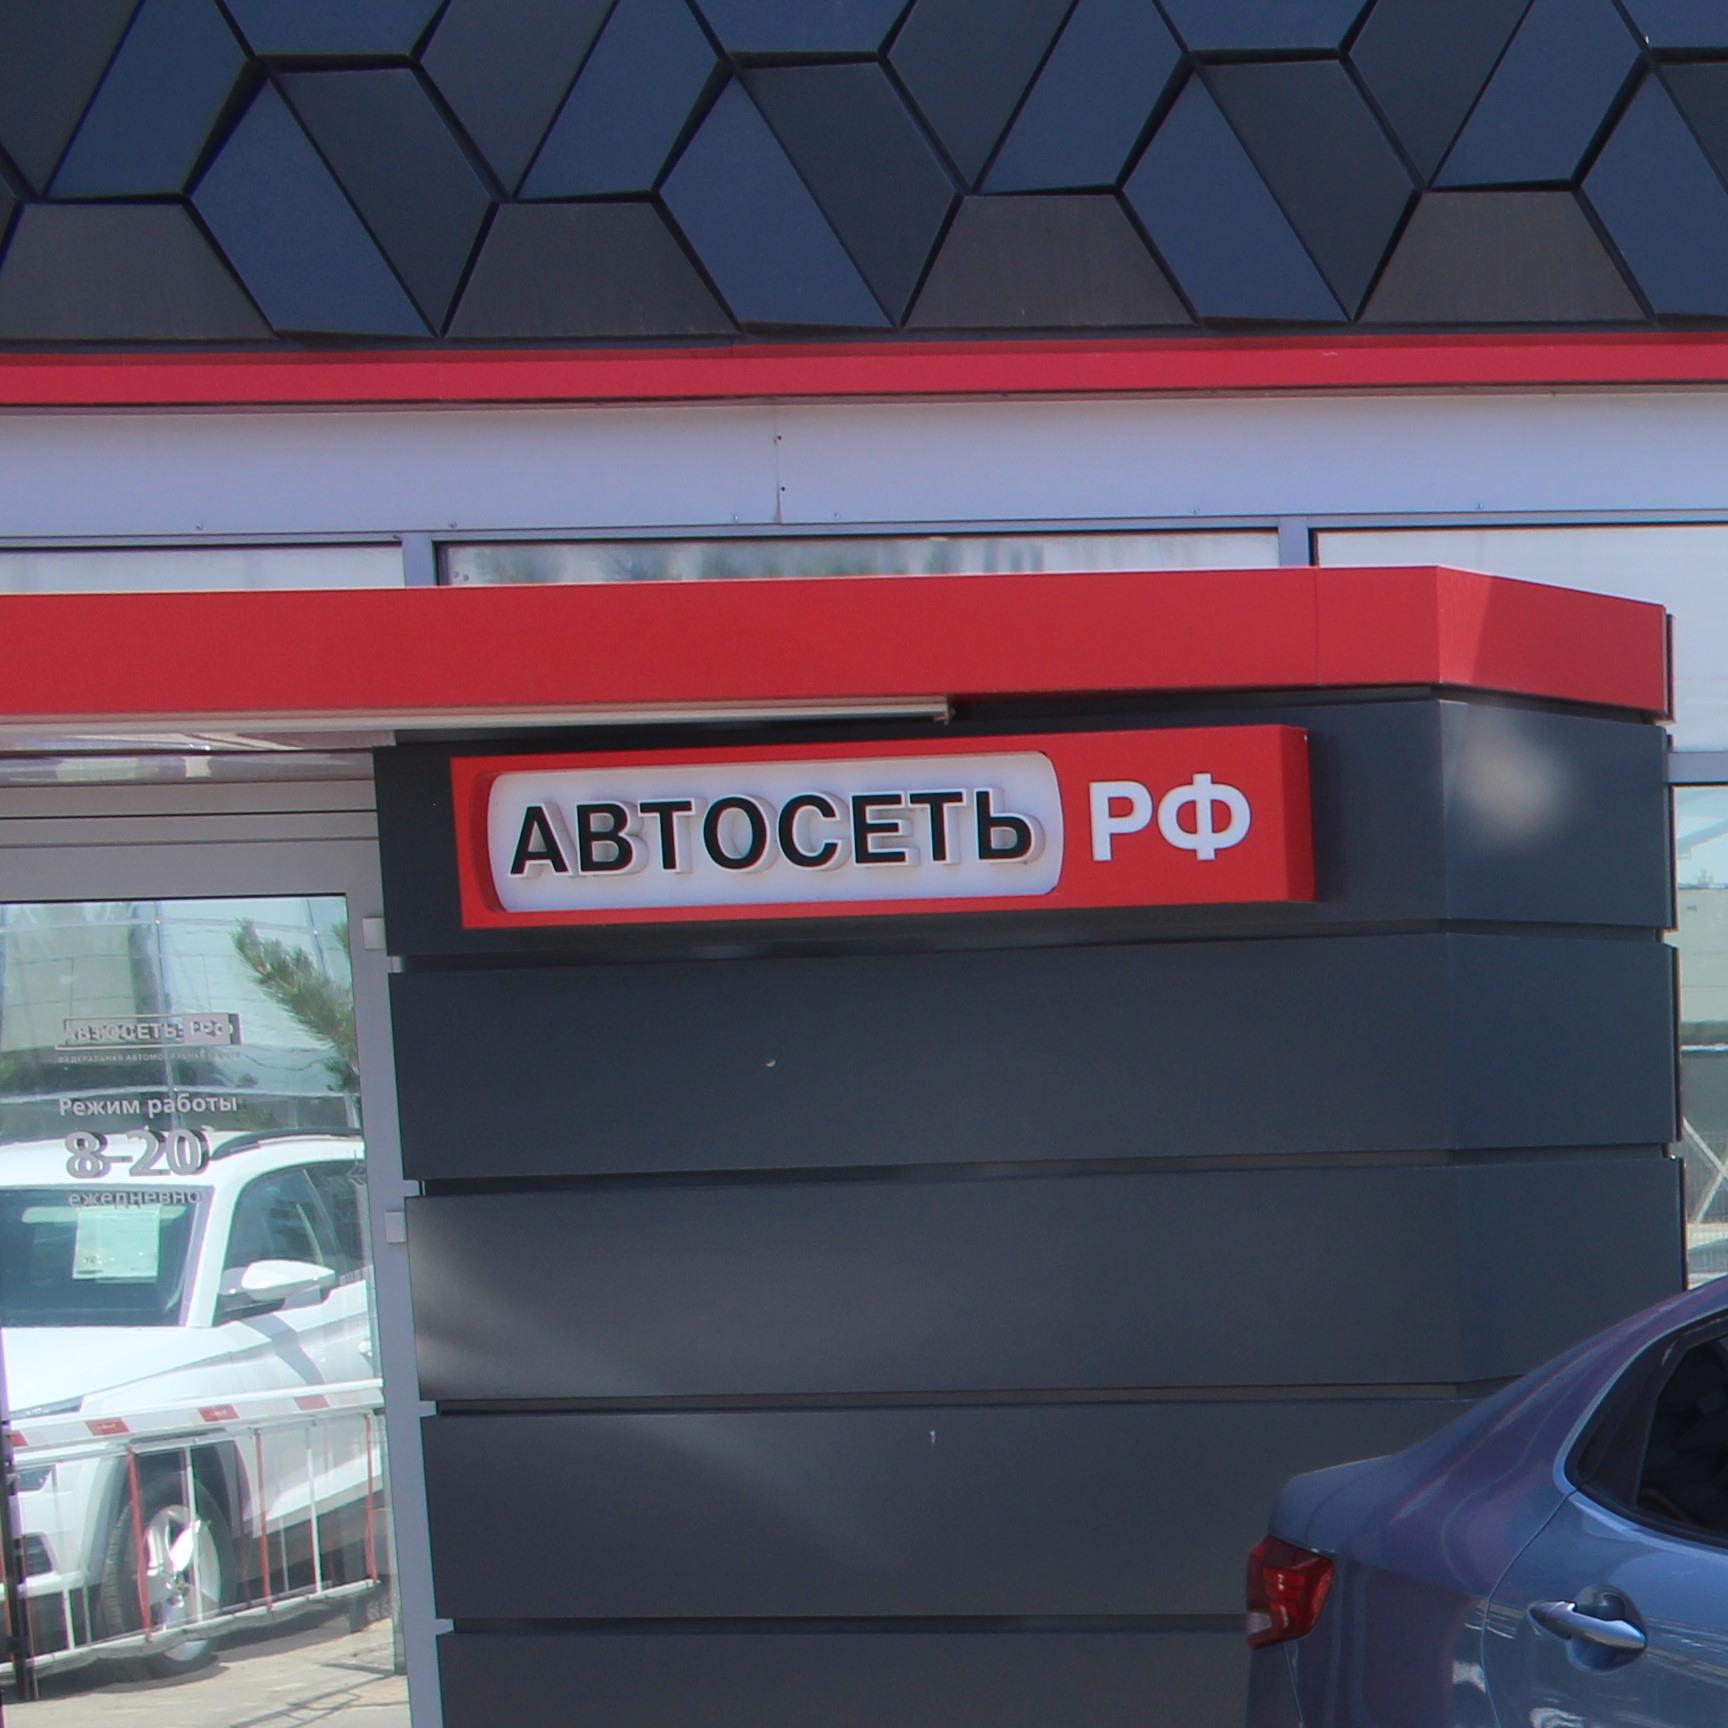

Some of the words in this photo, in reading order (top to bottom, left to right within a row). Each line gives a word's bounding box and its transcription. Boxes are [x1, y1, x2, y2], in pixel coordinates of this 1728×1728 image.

[509, 790, 1034, 876] АВТОСЕТЬ
[1089, 773, 1252, 862] РФ
[59, 1097, 141, 1117] Режим
[148, 1093, 238, 1119] работы
[68, 1190, 202, 1210] ежедневно
